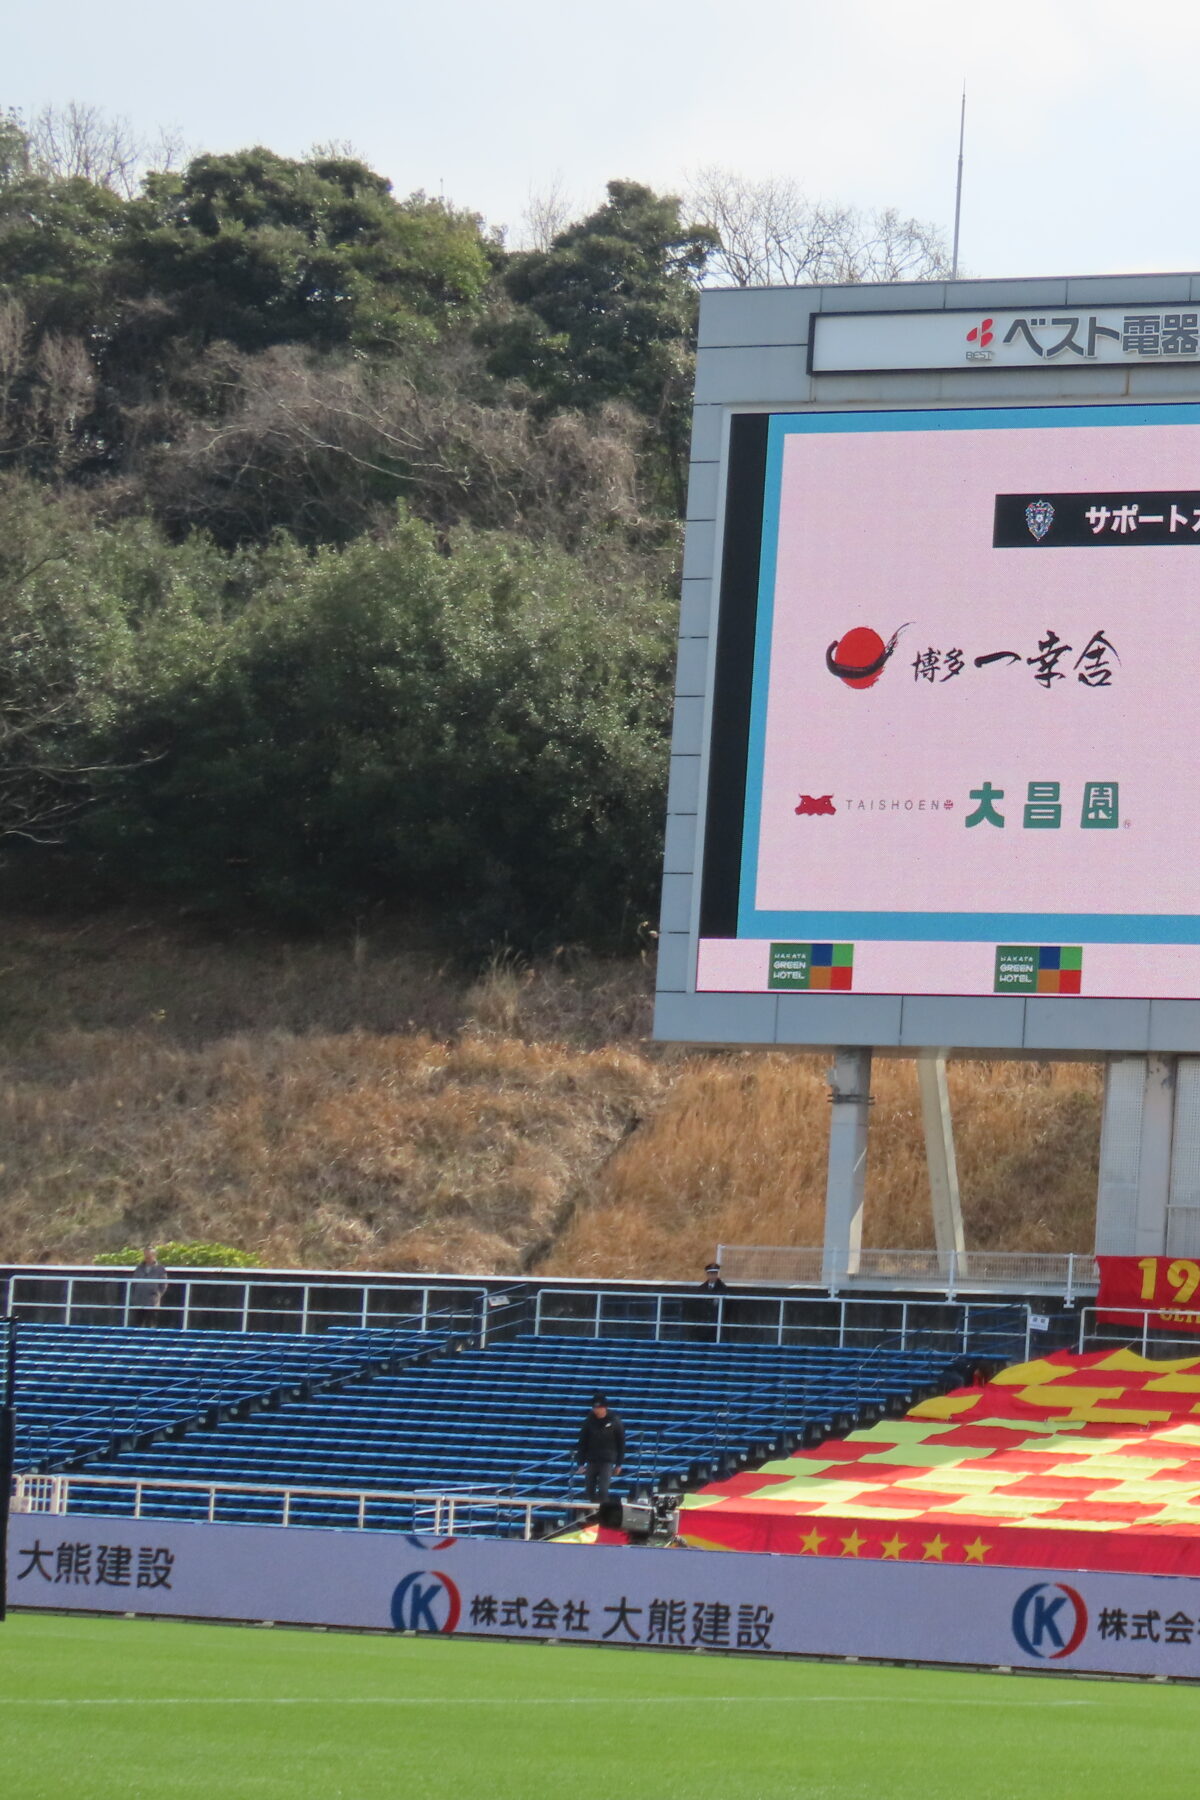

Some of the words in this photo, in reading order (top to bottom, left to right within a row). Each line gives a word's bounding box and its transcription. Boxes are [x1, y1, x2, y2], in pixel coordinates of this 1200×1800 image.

[1003, 313, 1199, 358] ベスト電器
[965, 350, 992, 361] BEST
[845, 799, 940, 811] TAISHOEN
[773, 961, 806, 970] GREEN
[999, 964, 1033, 973] GREEN
[772, 971, 805, 980] HOTEL
[999, 975, 1033, 983] HOTEL
[1138, 1257, 1200, 1304] 19
[17, 1540, 174, 1591] 大熊建設
[470, 1595, 590, 1633] 株式会社
[602, 1597, 774, 1650] 大熊建設
